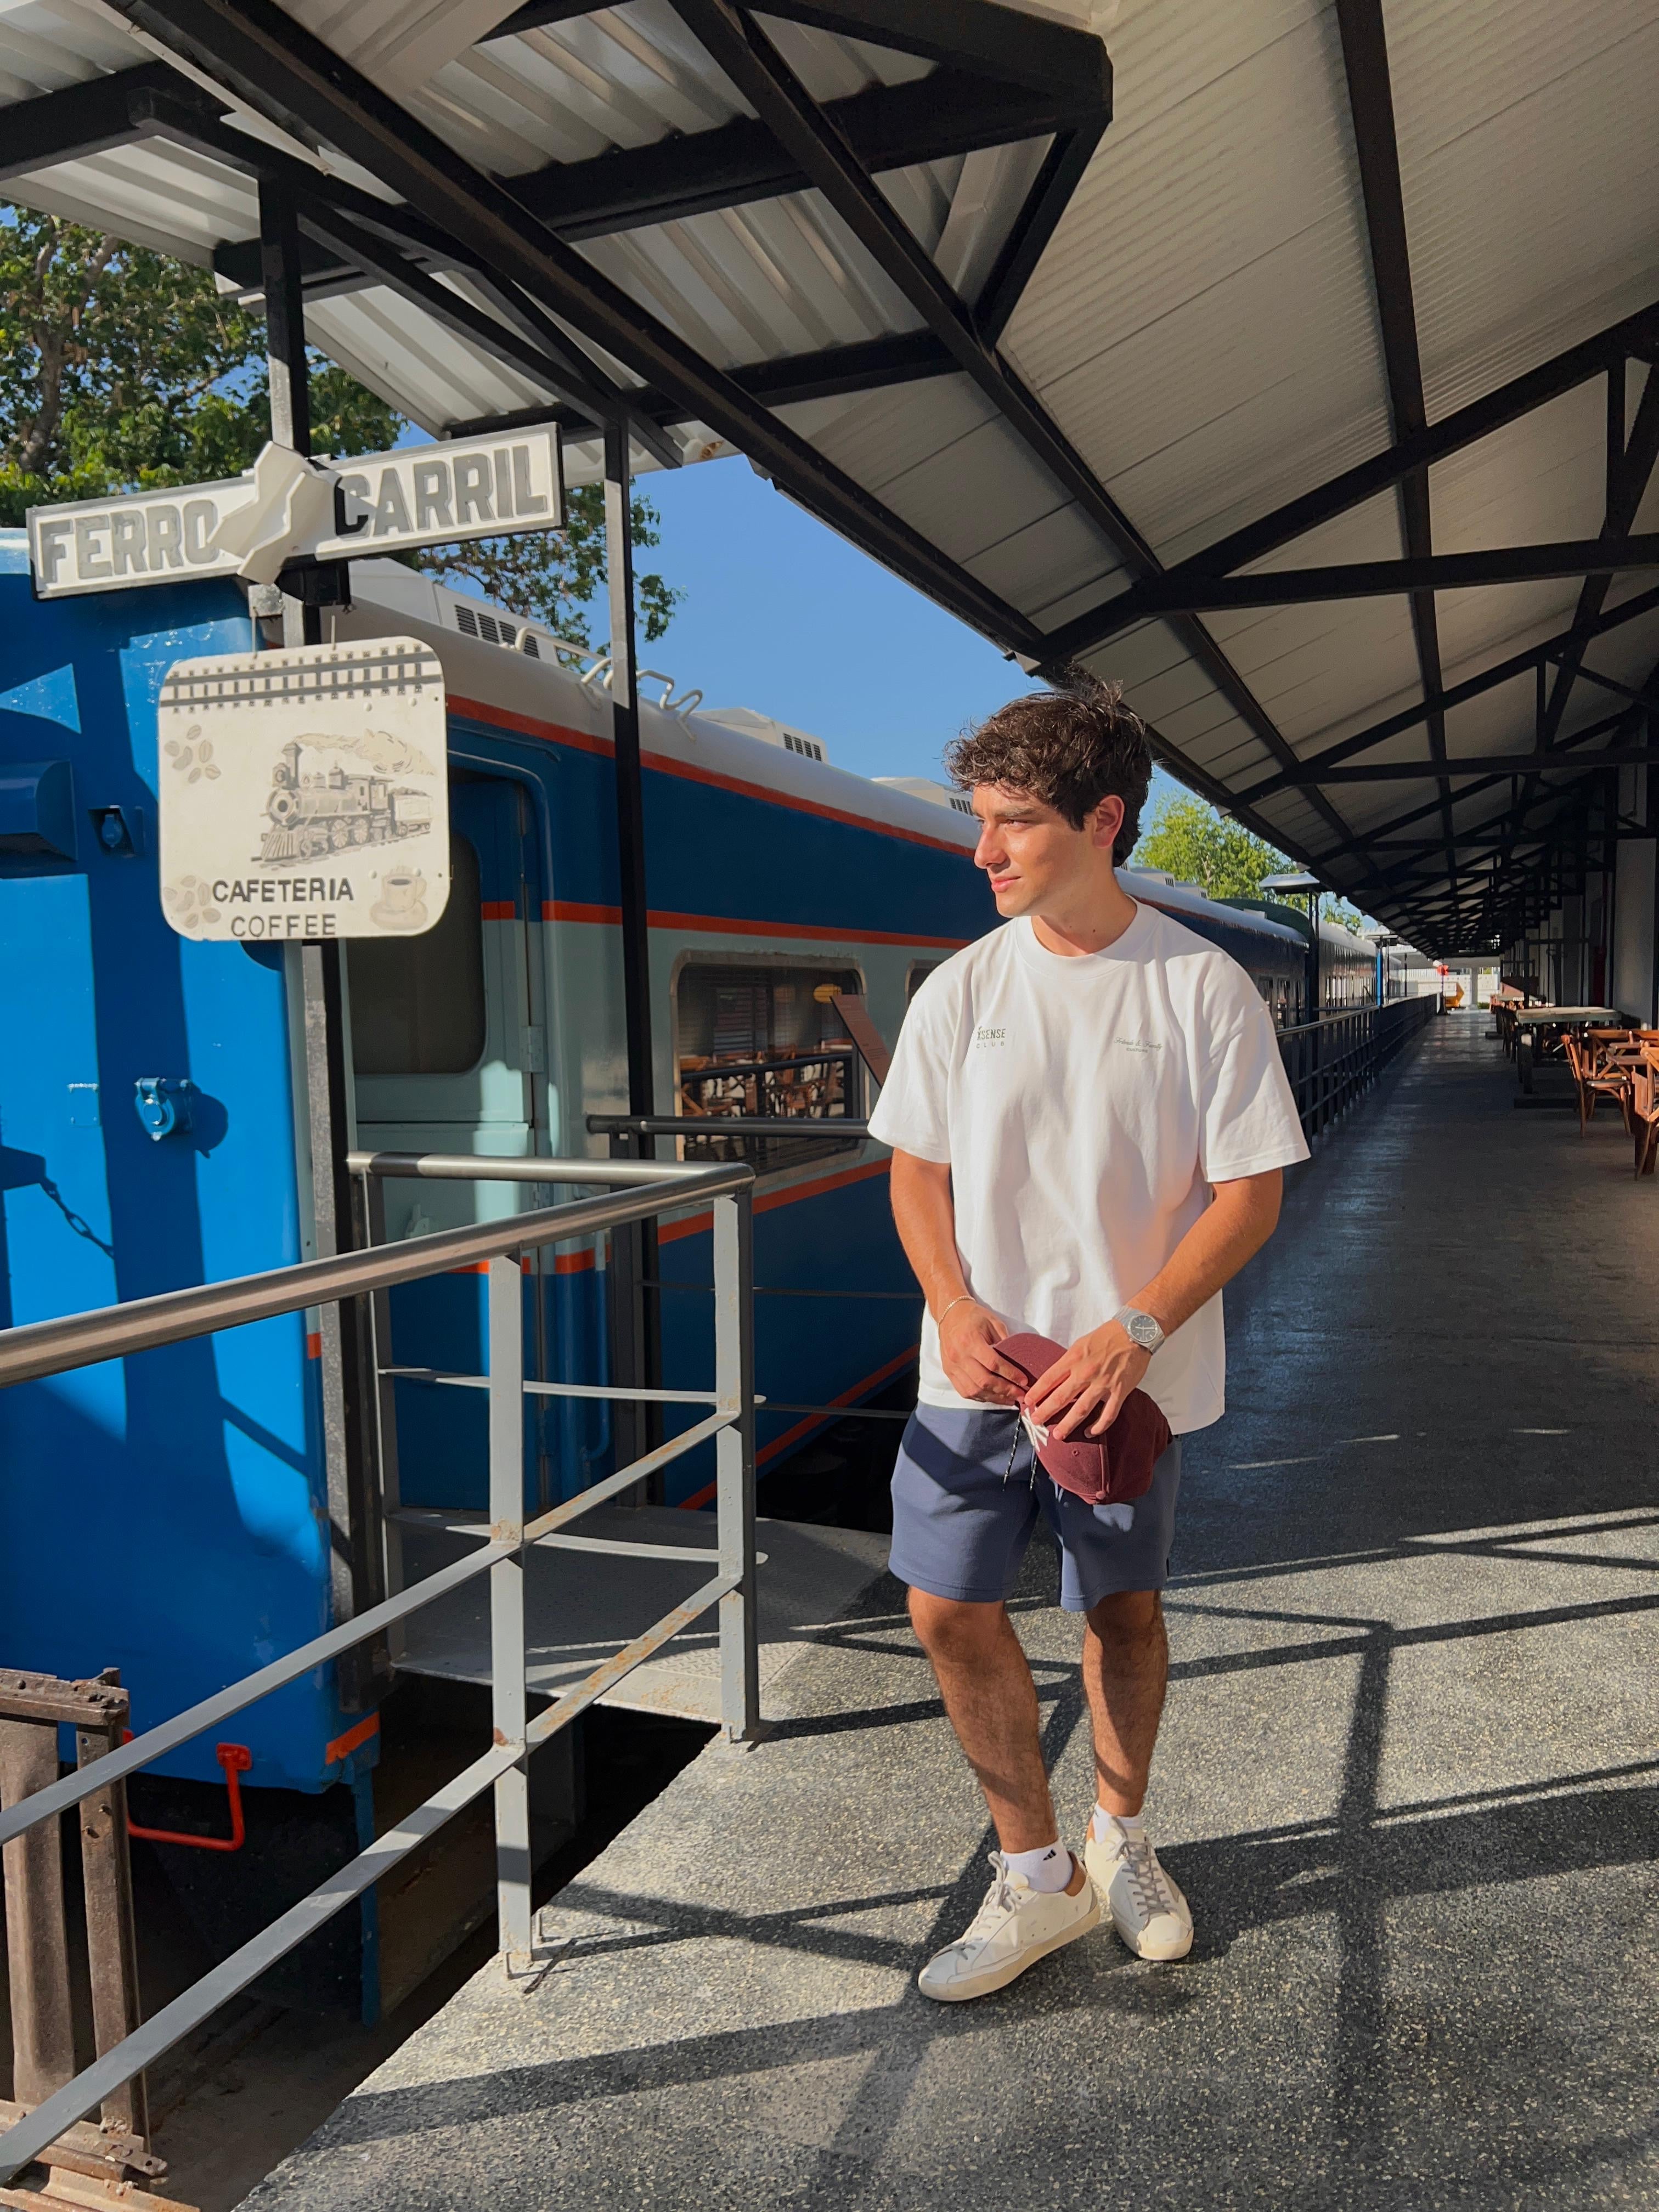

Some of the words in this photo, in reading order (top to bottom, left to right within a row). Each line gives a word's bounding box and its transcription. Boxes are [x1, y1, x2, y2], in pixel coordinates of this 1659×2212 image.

[39, 499, 220, 584] FERRO
[334, 444, 548, 540] CARRIL
[212, 877, 354, 902] CAFETERIA
[231, 914, 336, 937] COFFEE
